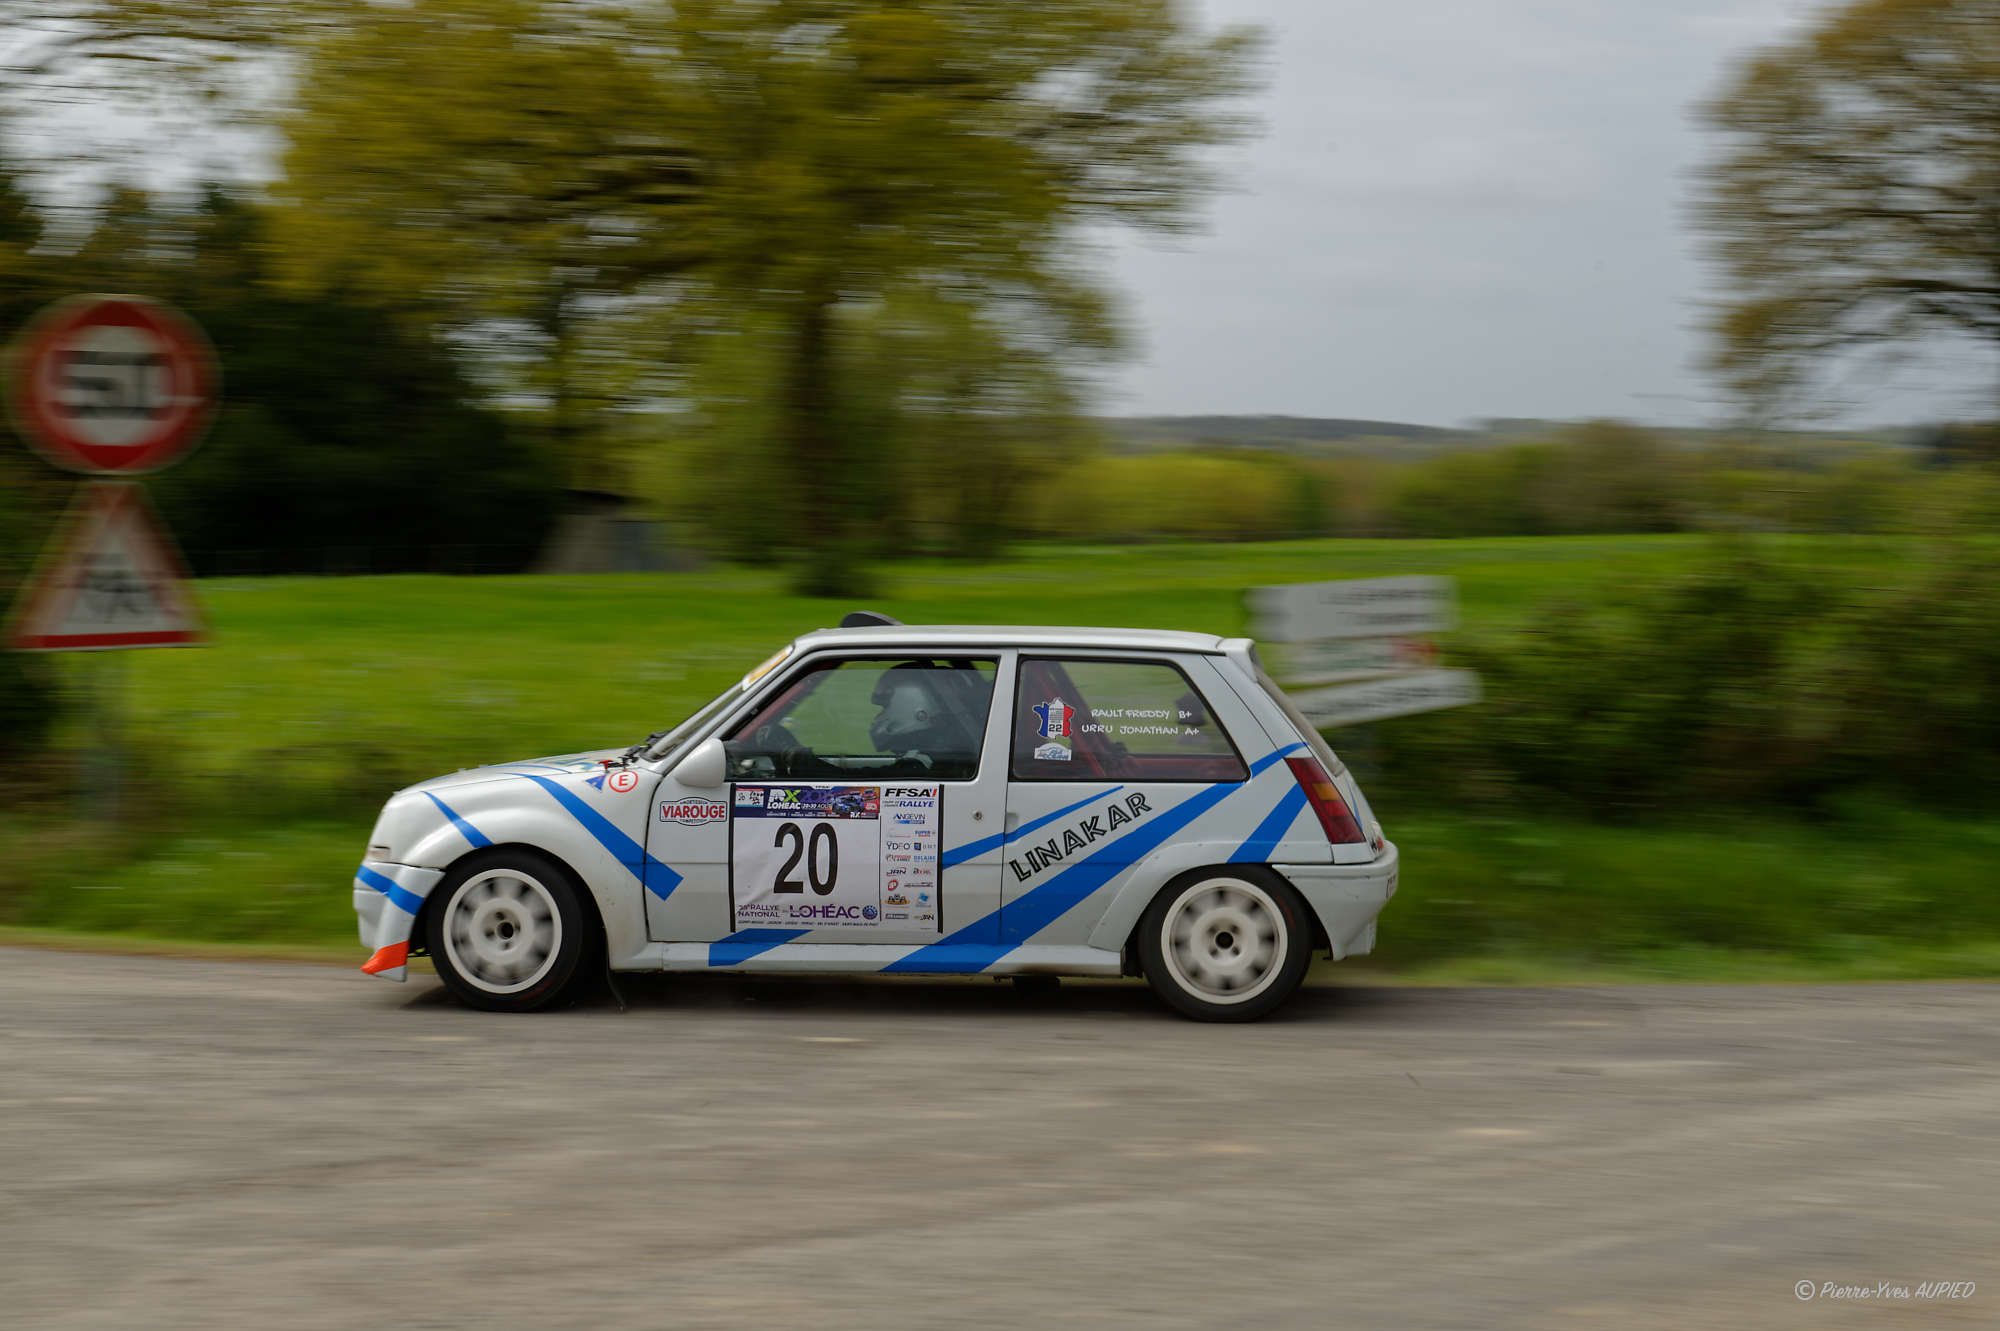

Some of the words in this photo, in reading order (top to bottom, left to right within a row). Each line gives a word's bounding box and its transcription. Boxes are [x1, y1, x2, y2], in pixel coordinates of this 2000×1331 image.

[1091, 708, 1124, 718] RAULT
[1126, 708, 1170, 720] FREDDY
[1178, 710, 1192, 719] B+
[1048, 724, 1062, 732] 22
[1082, 724, 1113, 733] URRU
[1120, 725, 1178, 735] JONATHAN
[1185, 727, 1199, 735] A+
[618, 774, 629, 787] E
[885, 788, 931, 797] FFSA
[662, 805, 725, 818] VIAROUGE
[767, 802, 801, 810] LOHEAC
[1009, 792, 1153, 882] LINAKAR
[773, 822, 838, 896] 20
[789, 904, 860, 919] LOHÉAC
